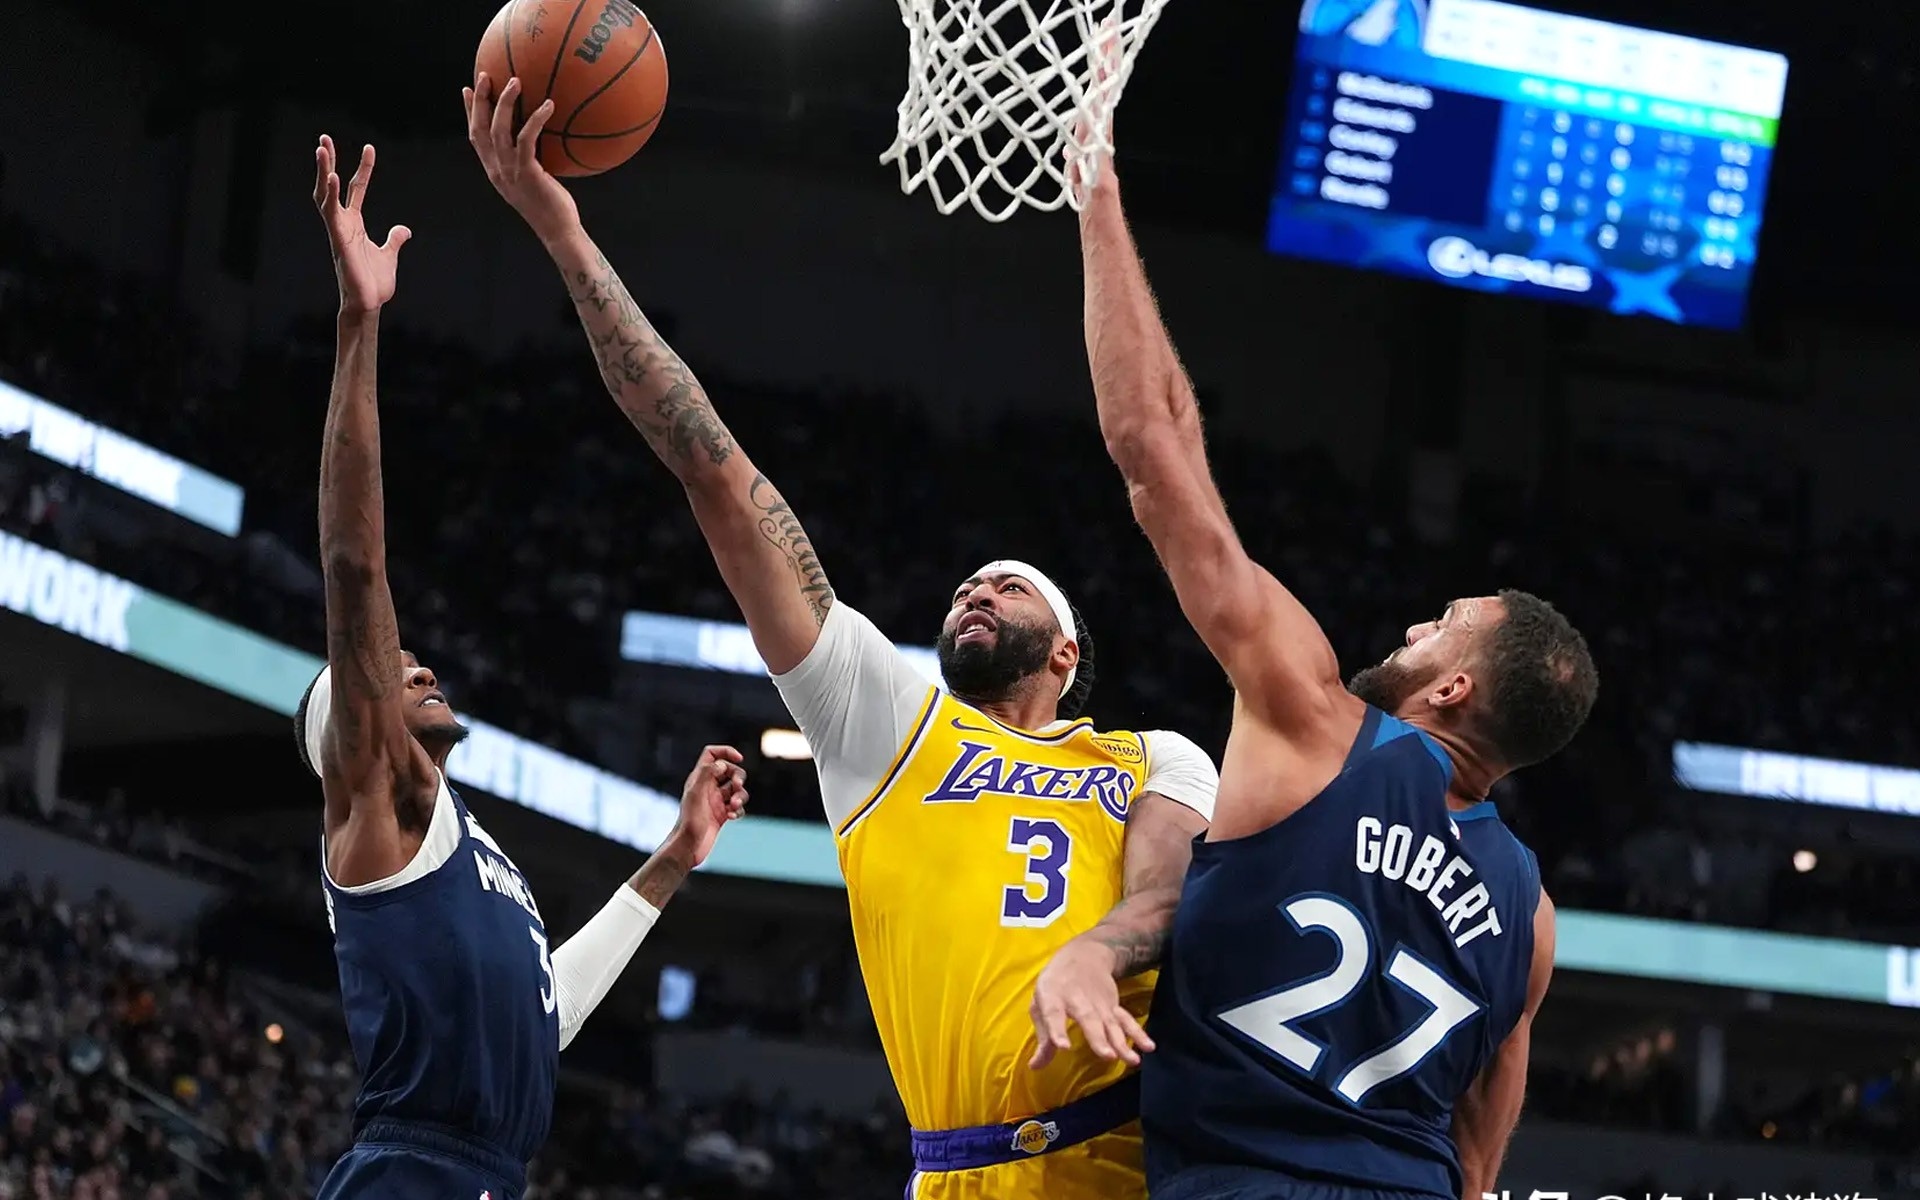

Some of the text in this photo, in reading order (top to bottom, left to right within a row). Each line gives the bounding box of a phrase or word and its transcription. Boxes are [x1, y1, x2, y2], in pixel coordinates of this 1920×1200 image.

[921, 741, 1135, 823] LAKERS
[1001, 816, 1072, 928] 3
[1356, 816, 1502, 948] GOBERT
[1214, 894, 1484, 1105] 27
